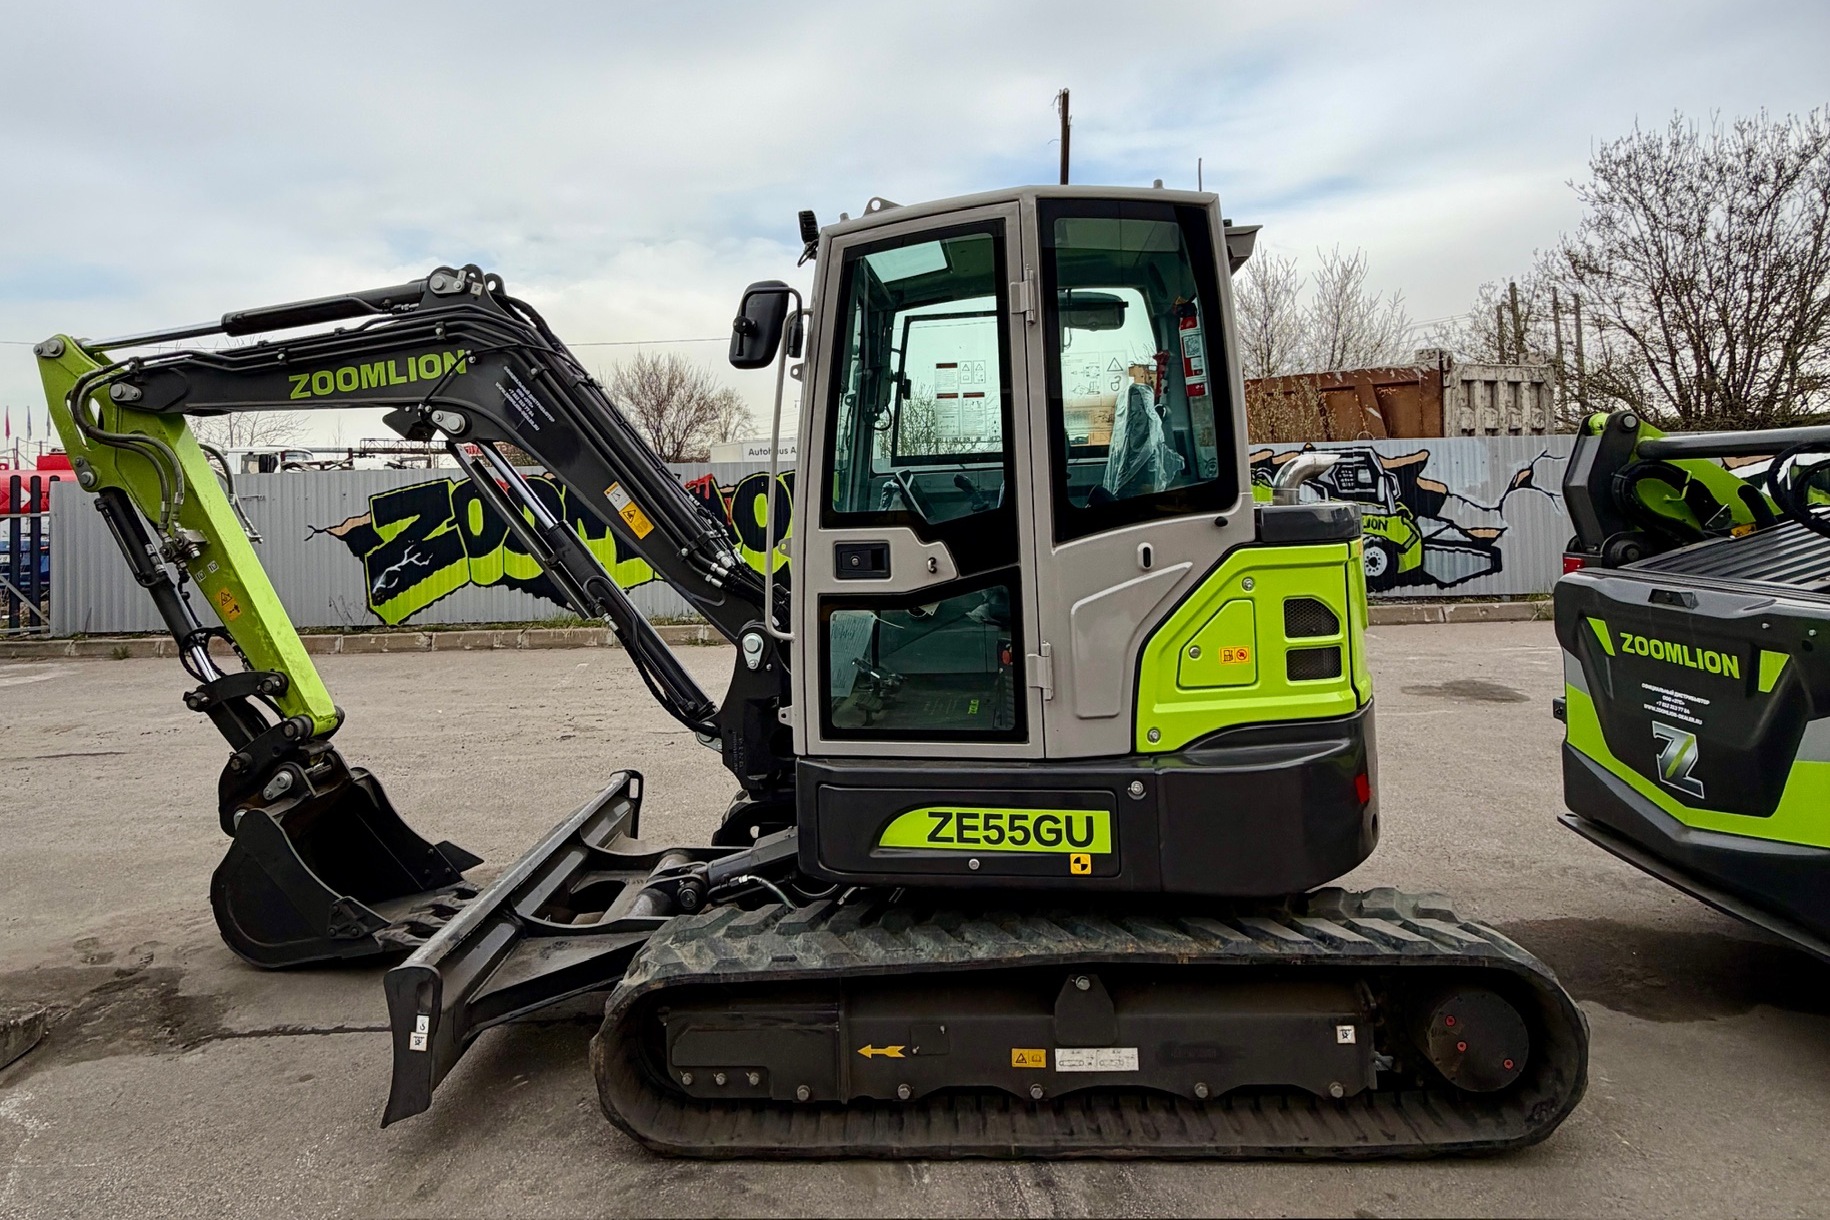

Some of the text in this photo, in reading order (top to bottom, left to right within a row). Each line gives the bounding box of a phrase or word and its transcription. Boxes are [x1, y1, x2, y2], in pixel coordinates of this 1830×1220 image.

[288, 349, 467, 400] ZOOMLION
[748, 446, 789, 456] Autohus
[1620, 632, 1740, 679] ZOOMLION
[927, 811, 1094, 848] ZE55GU
